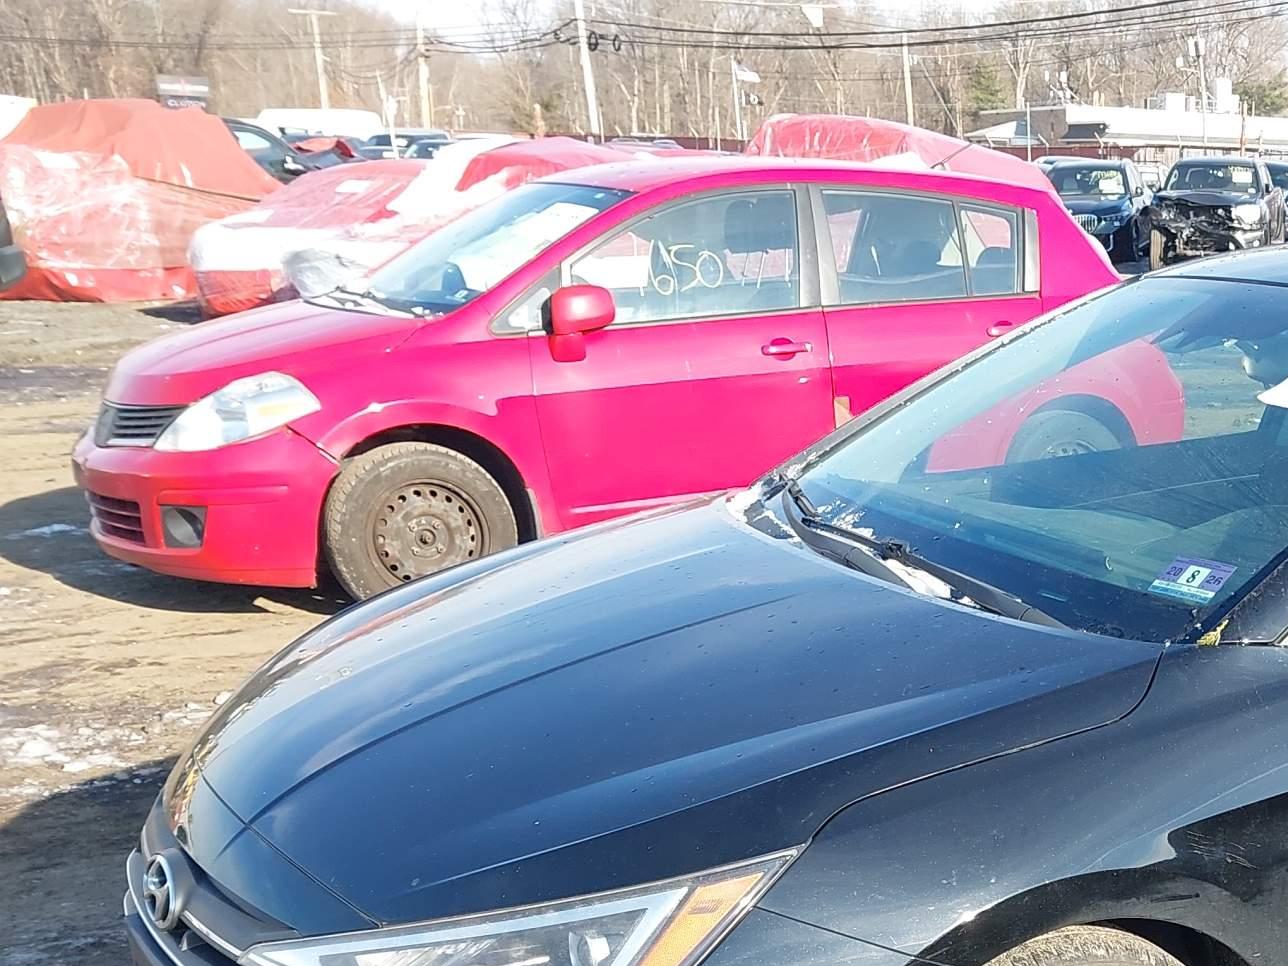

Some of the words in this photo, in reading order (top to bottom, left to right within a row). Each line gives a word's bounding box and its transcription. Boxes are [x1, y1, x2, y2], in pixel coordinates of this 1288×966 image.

[1166, 566, 1183, 577] 20
[1186, 569, 1201, 584] 8
[1206, 575, 1223, 586] 26
